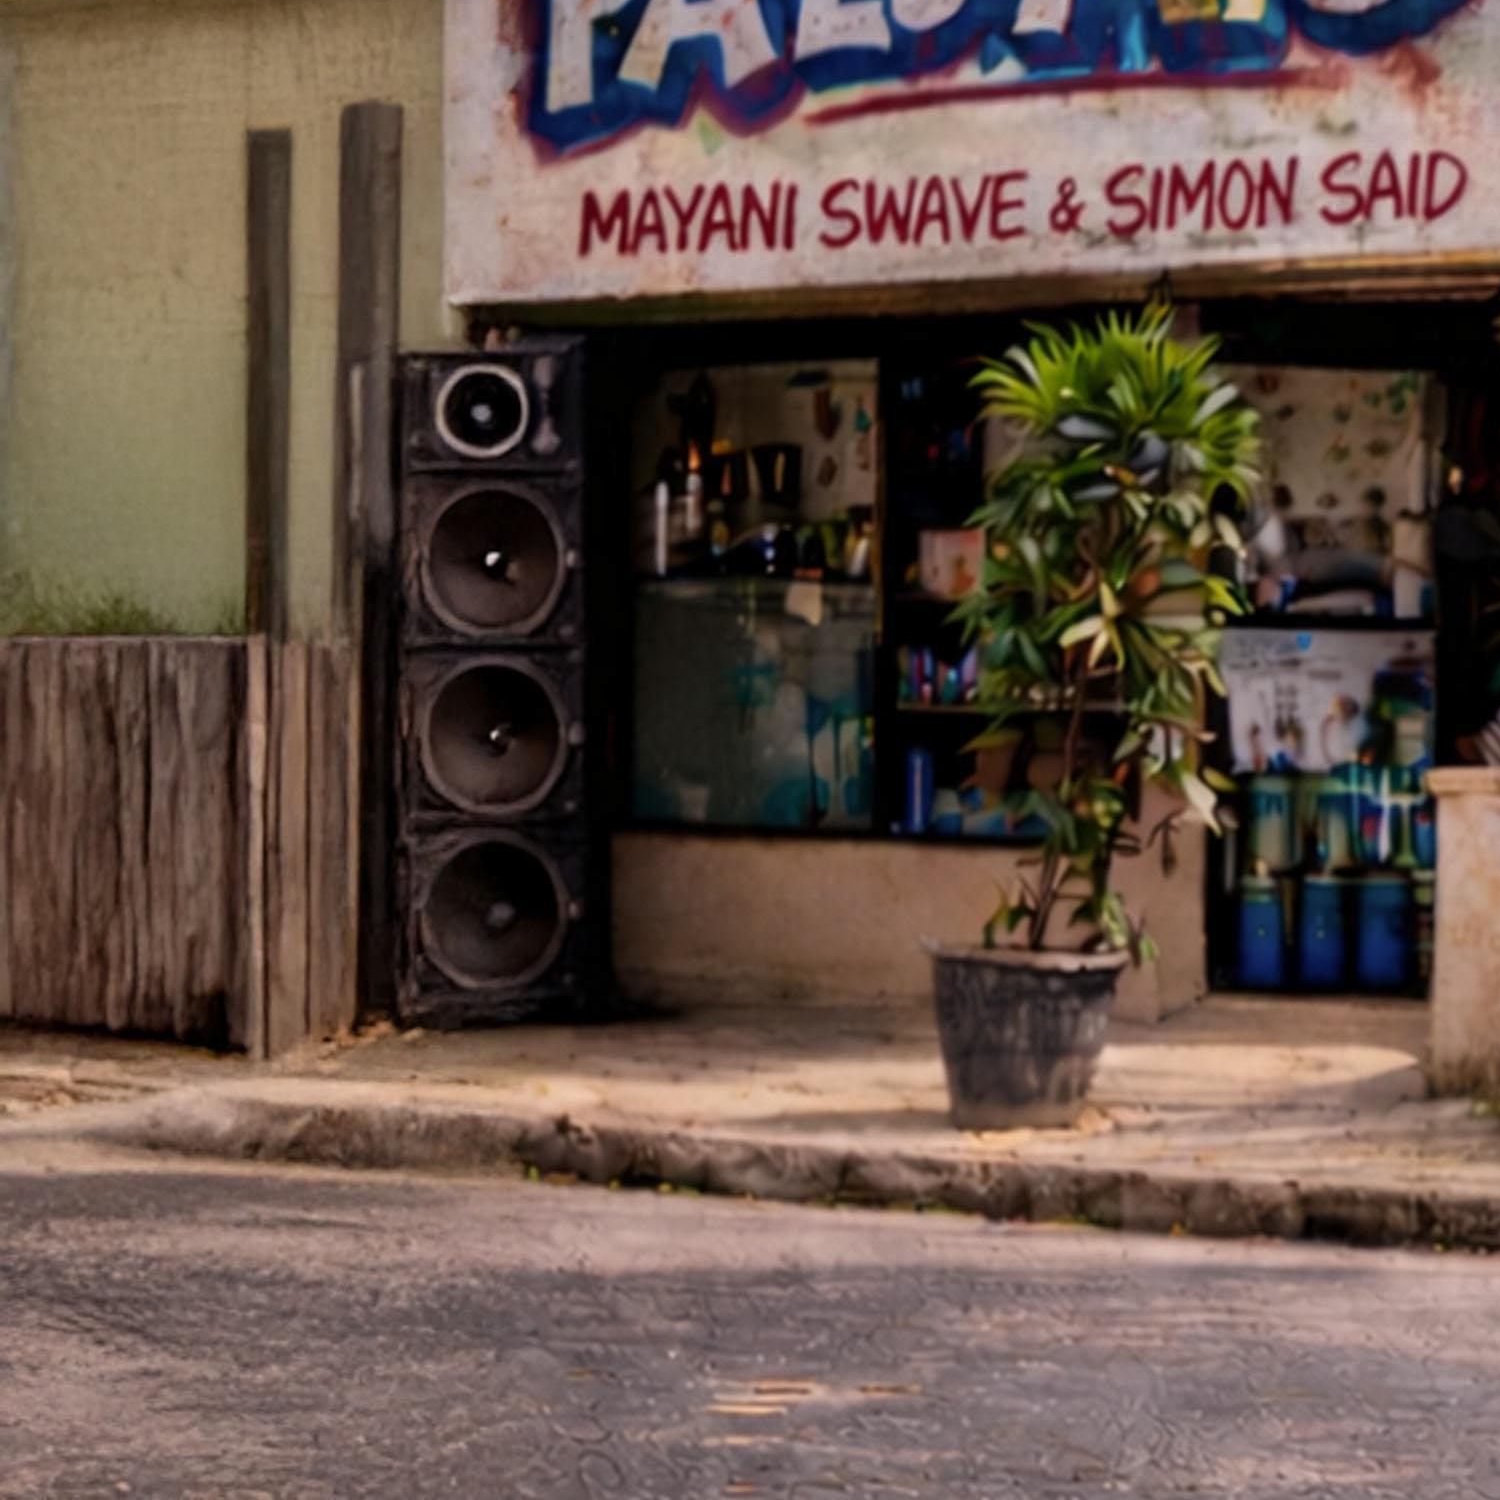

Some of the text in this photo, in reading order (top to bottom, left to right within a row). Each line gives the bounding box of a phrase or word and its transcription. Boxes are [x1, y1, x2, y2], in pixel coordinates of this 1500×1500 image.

[578, 149, 1469, 258] MAYANI SWAVE & SIMON SAID
